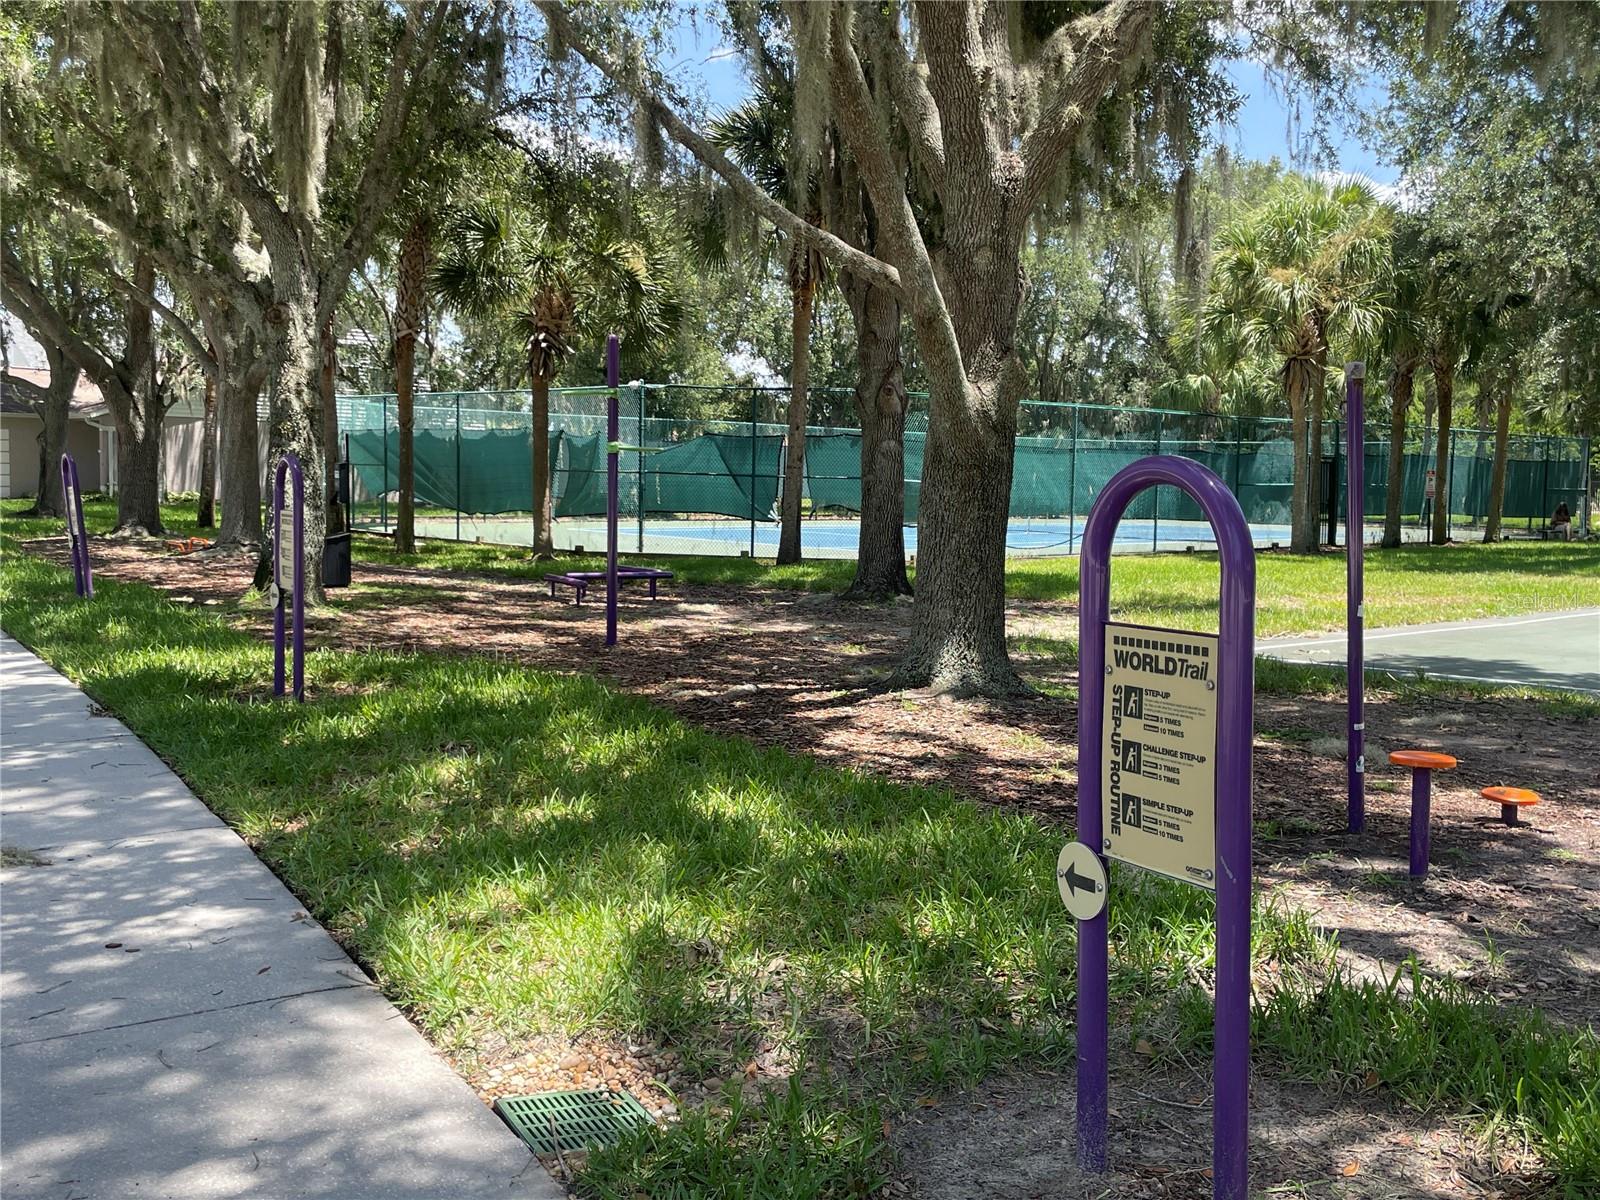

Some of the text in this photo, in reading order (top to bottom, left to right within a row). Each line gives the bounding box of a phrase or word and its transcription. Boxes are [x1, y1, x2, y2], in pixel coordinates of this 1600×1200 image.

[1144, 688, 1171, 699] STEP-UP
[1164, 717, 1182, 727] TIMES
[1167, 729, 1184, 738] TIMES
[1142, 744, 1178, 758] CHALLENGE
[1179, 752, 1206, 764] STEP-UP
[1111, 684, 1122, 836] STEP-UP ROUTINE
[1163, 765, 1180, 775] TIMES
[1163, 776, 1180, 785] TIMES
[1142, 798, 1166, 811] SIMPLE
[1166, 804, 1194, 817] STEP-UP
[1163, 821, 1180, 831] TIMES
[1159, 830, 1166, 838] 10
[1166, 832, 1184, 843] TIMES
